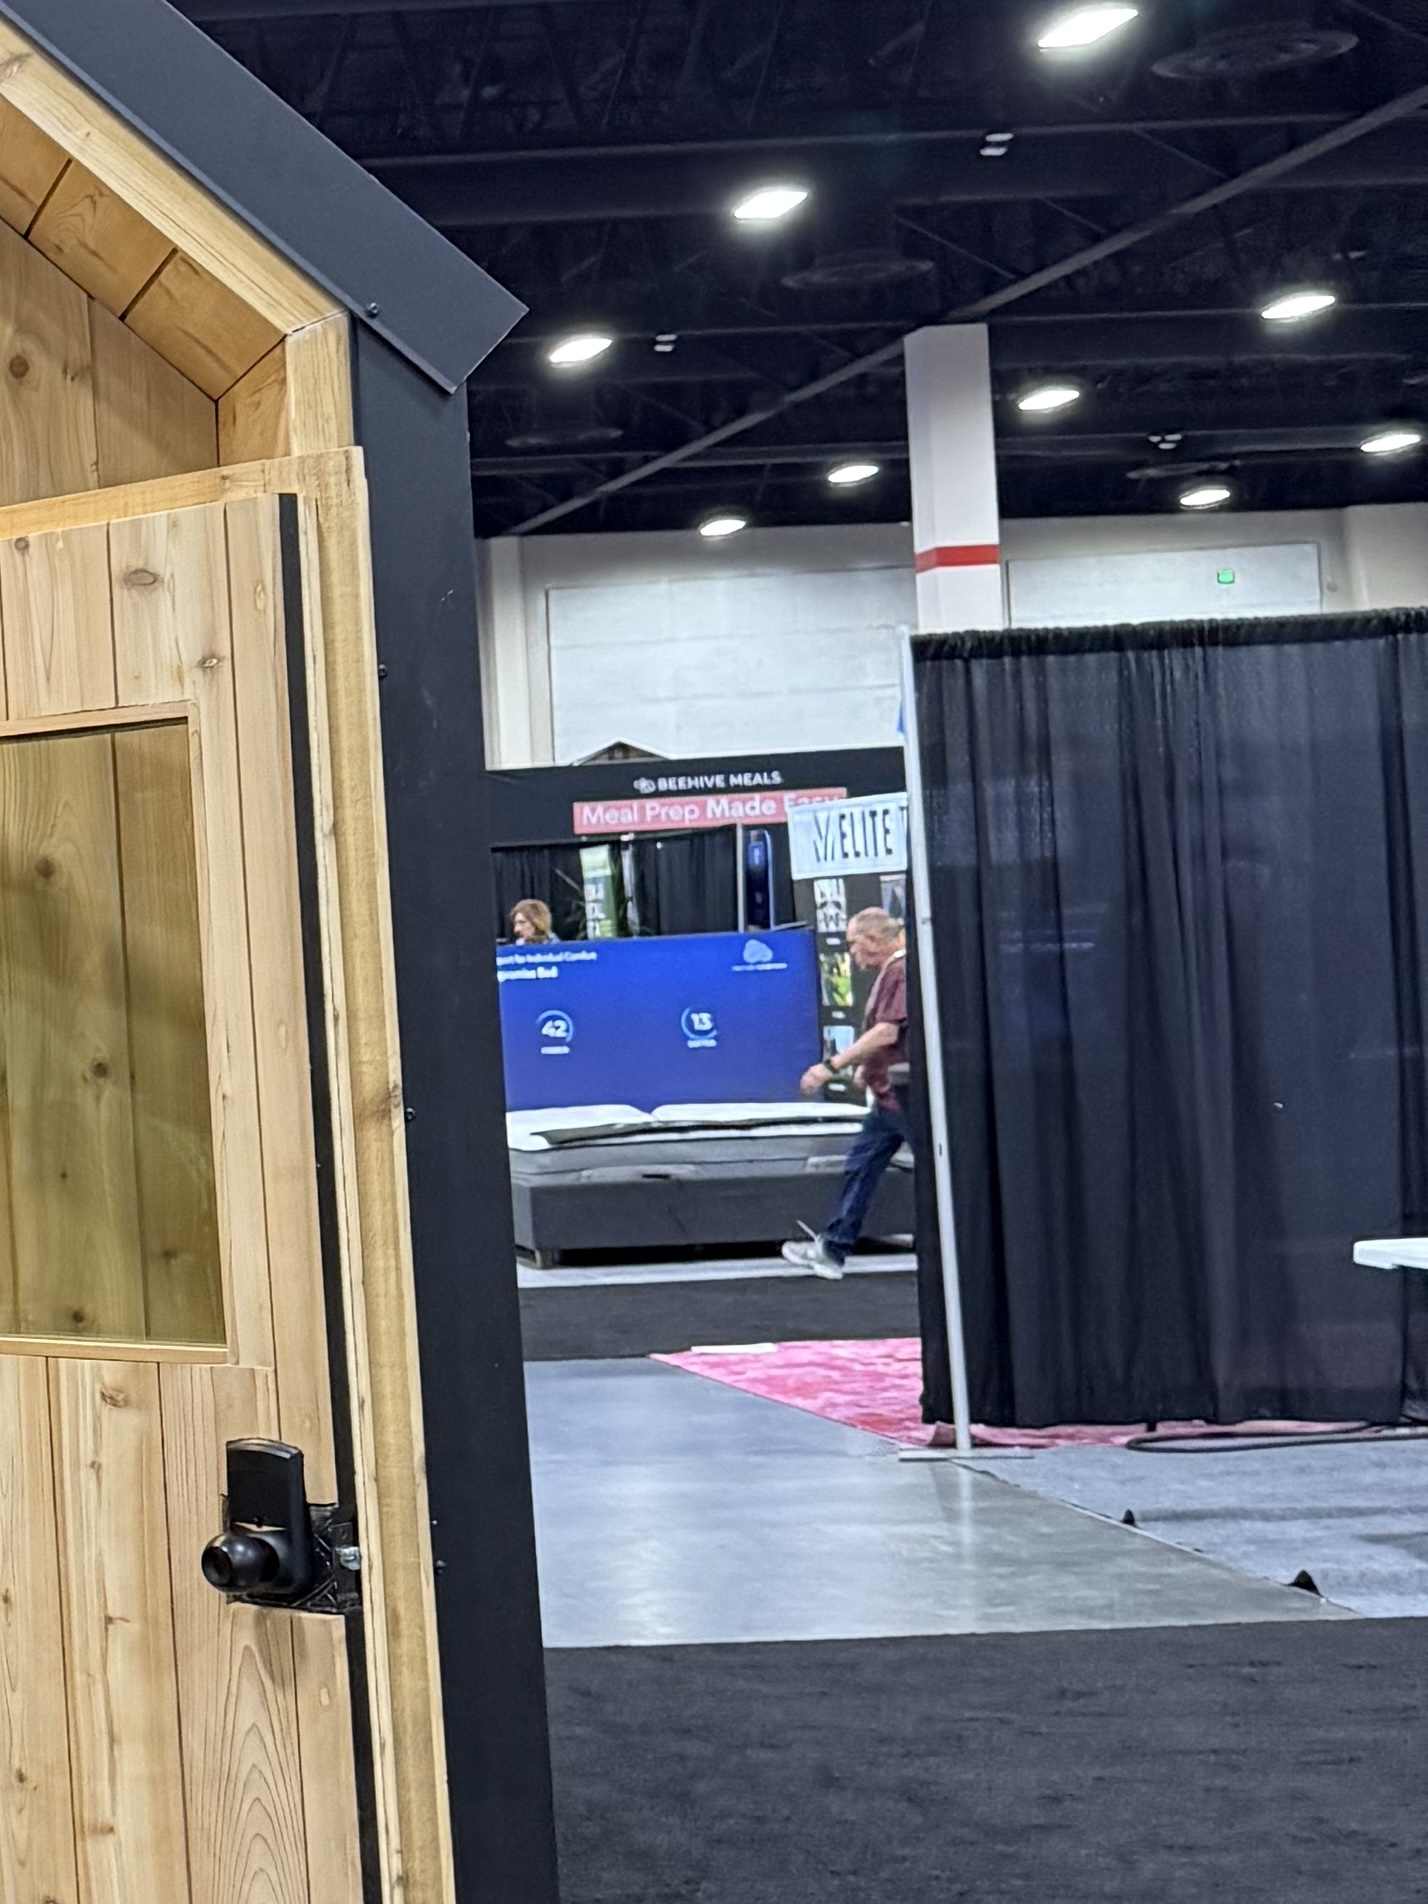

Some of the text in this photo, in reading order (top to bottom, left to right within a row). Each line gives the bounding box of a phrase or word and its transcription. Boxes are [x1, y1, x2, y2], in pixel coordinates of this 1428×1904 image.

[657, 771, 782, 791] BEEHIVE MEALS
[582, 803, 638, 825] Meal
[645, 801, 700, 824] Prep
[707, 795, 777, 819] Made
[839, 808, 894, 859] ELITE
